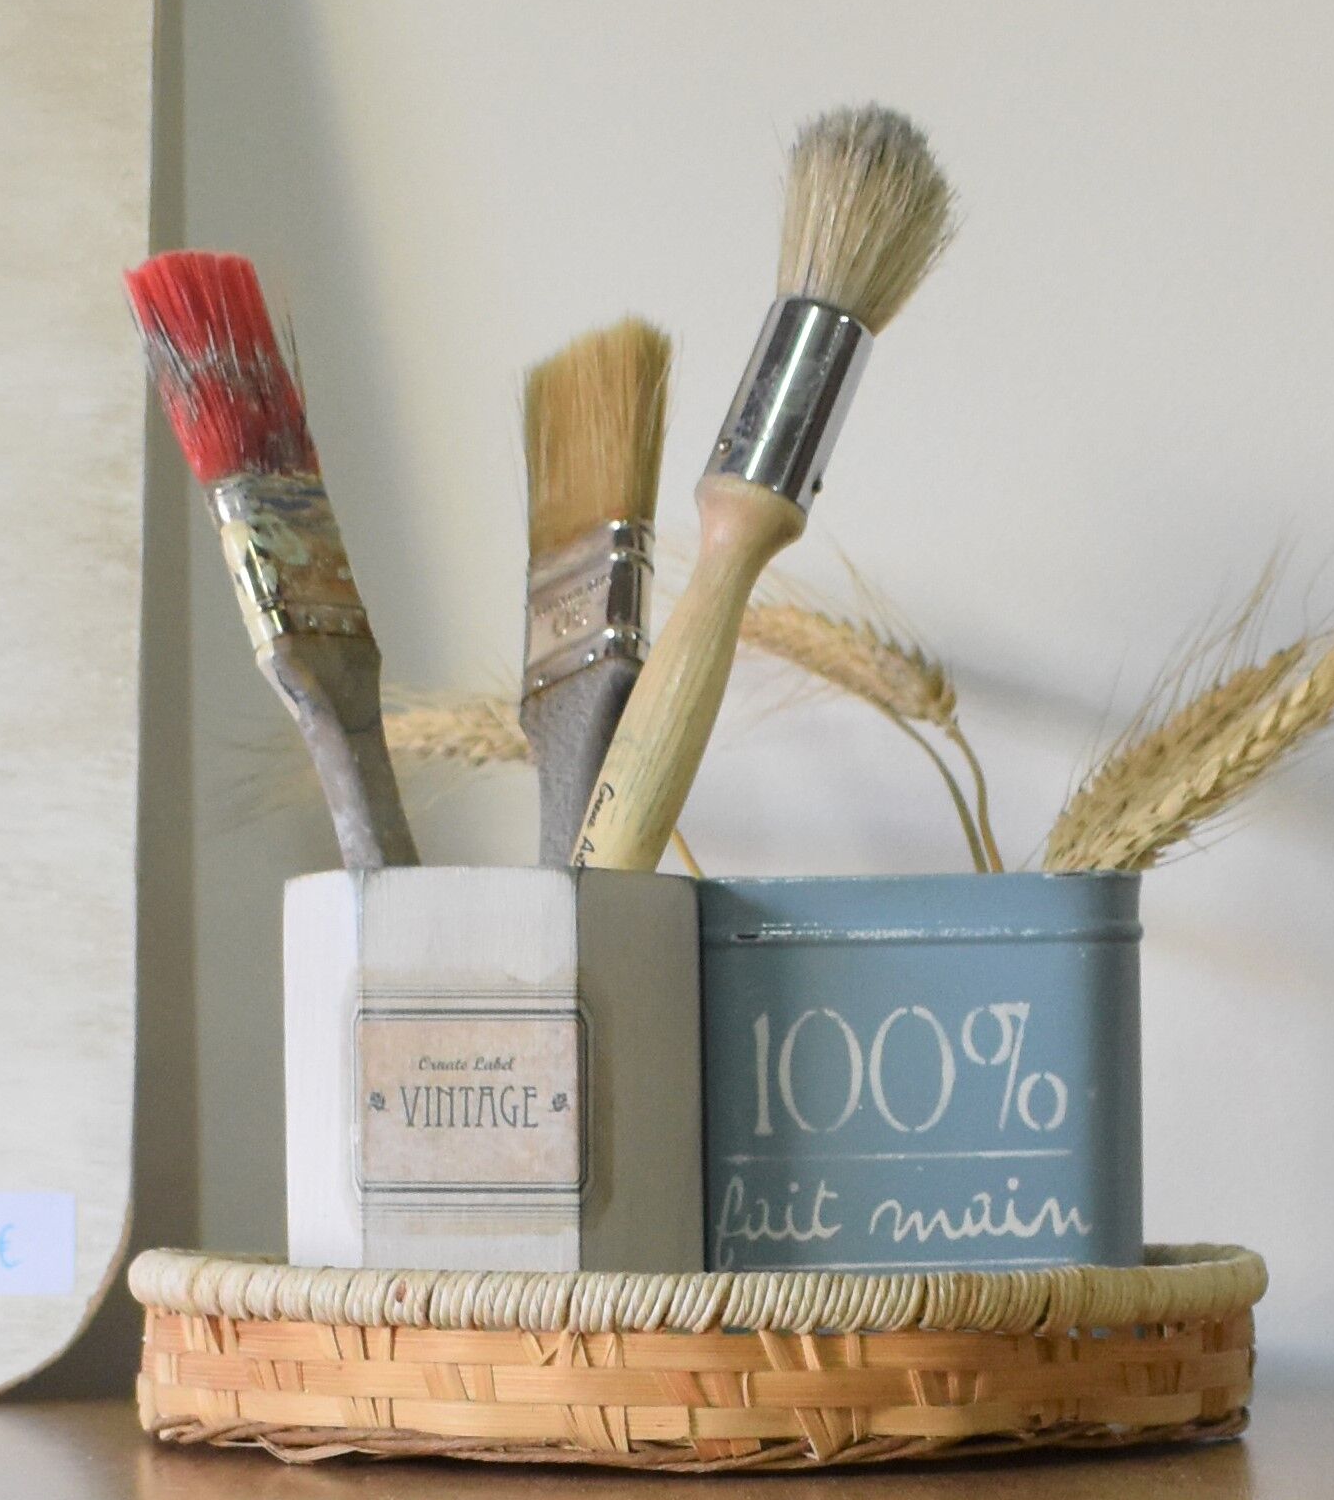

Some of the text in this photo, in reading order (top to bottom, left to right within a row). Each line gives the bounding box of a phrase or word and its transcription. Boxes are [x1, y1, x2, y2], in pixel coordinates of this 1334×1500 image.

[473, 1056, 516, 1072] Label
[754, 1002, 1068, 1135] 100%
[400, 1086, 539, 1128] VINTAGE
[715, 1176, 1093, 1271] fait main
